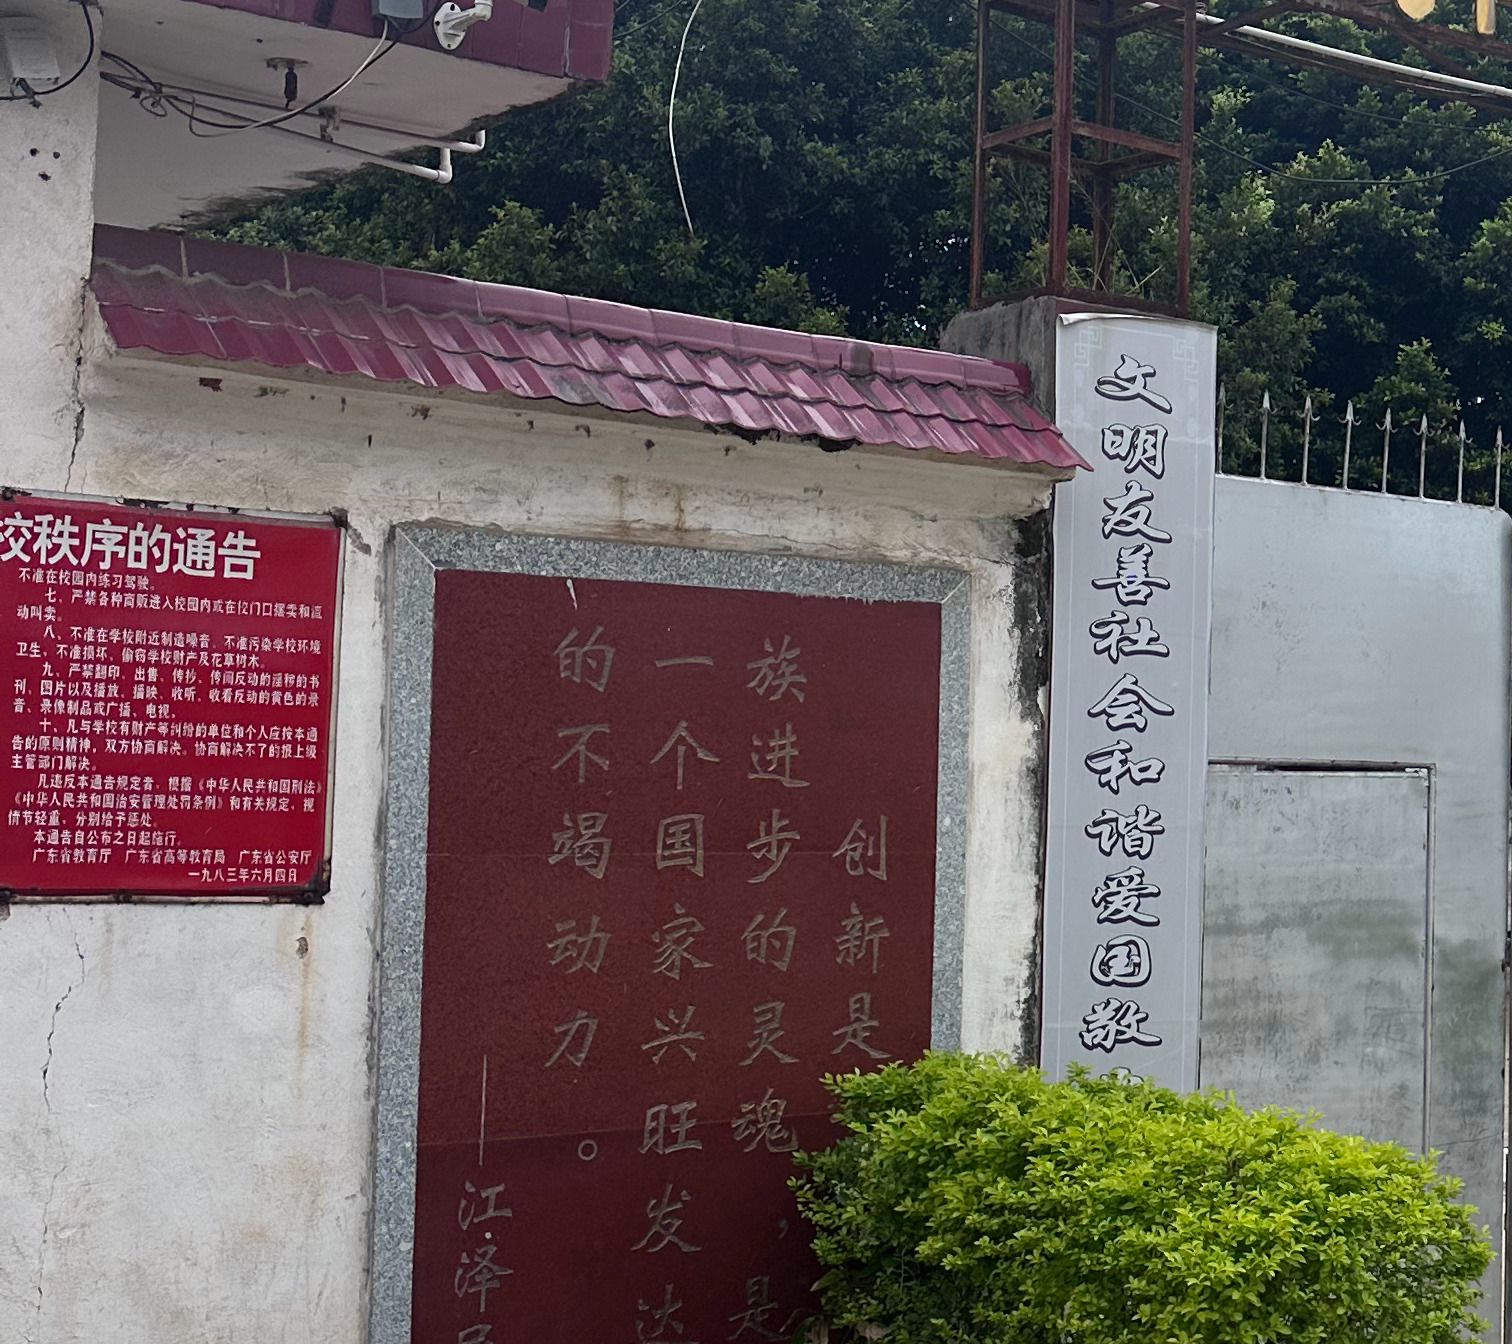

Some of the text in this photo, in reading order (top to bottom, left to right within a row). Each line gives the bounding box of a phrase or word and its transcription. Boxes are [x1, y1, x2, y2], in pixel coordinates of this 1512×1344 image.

[1079, 354, 1173, 1086] 文明友善社会和谐爱国敬
[32, 847, 313, 865] 广东省教育厅 广东省高等教育局 广东省公安厅
[188, 867, 298, 884] 一九八三年六月四日
